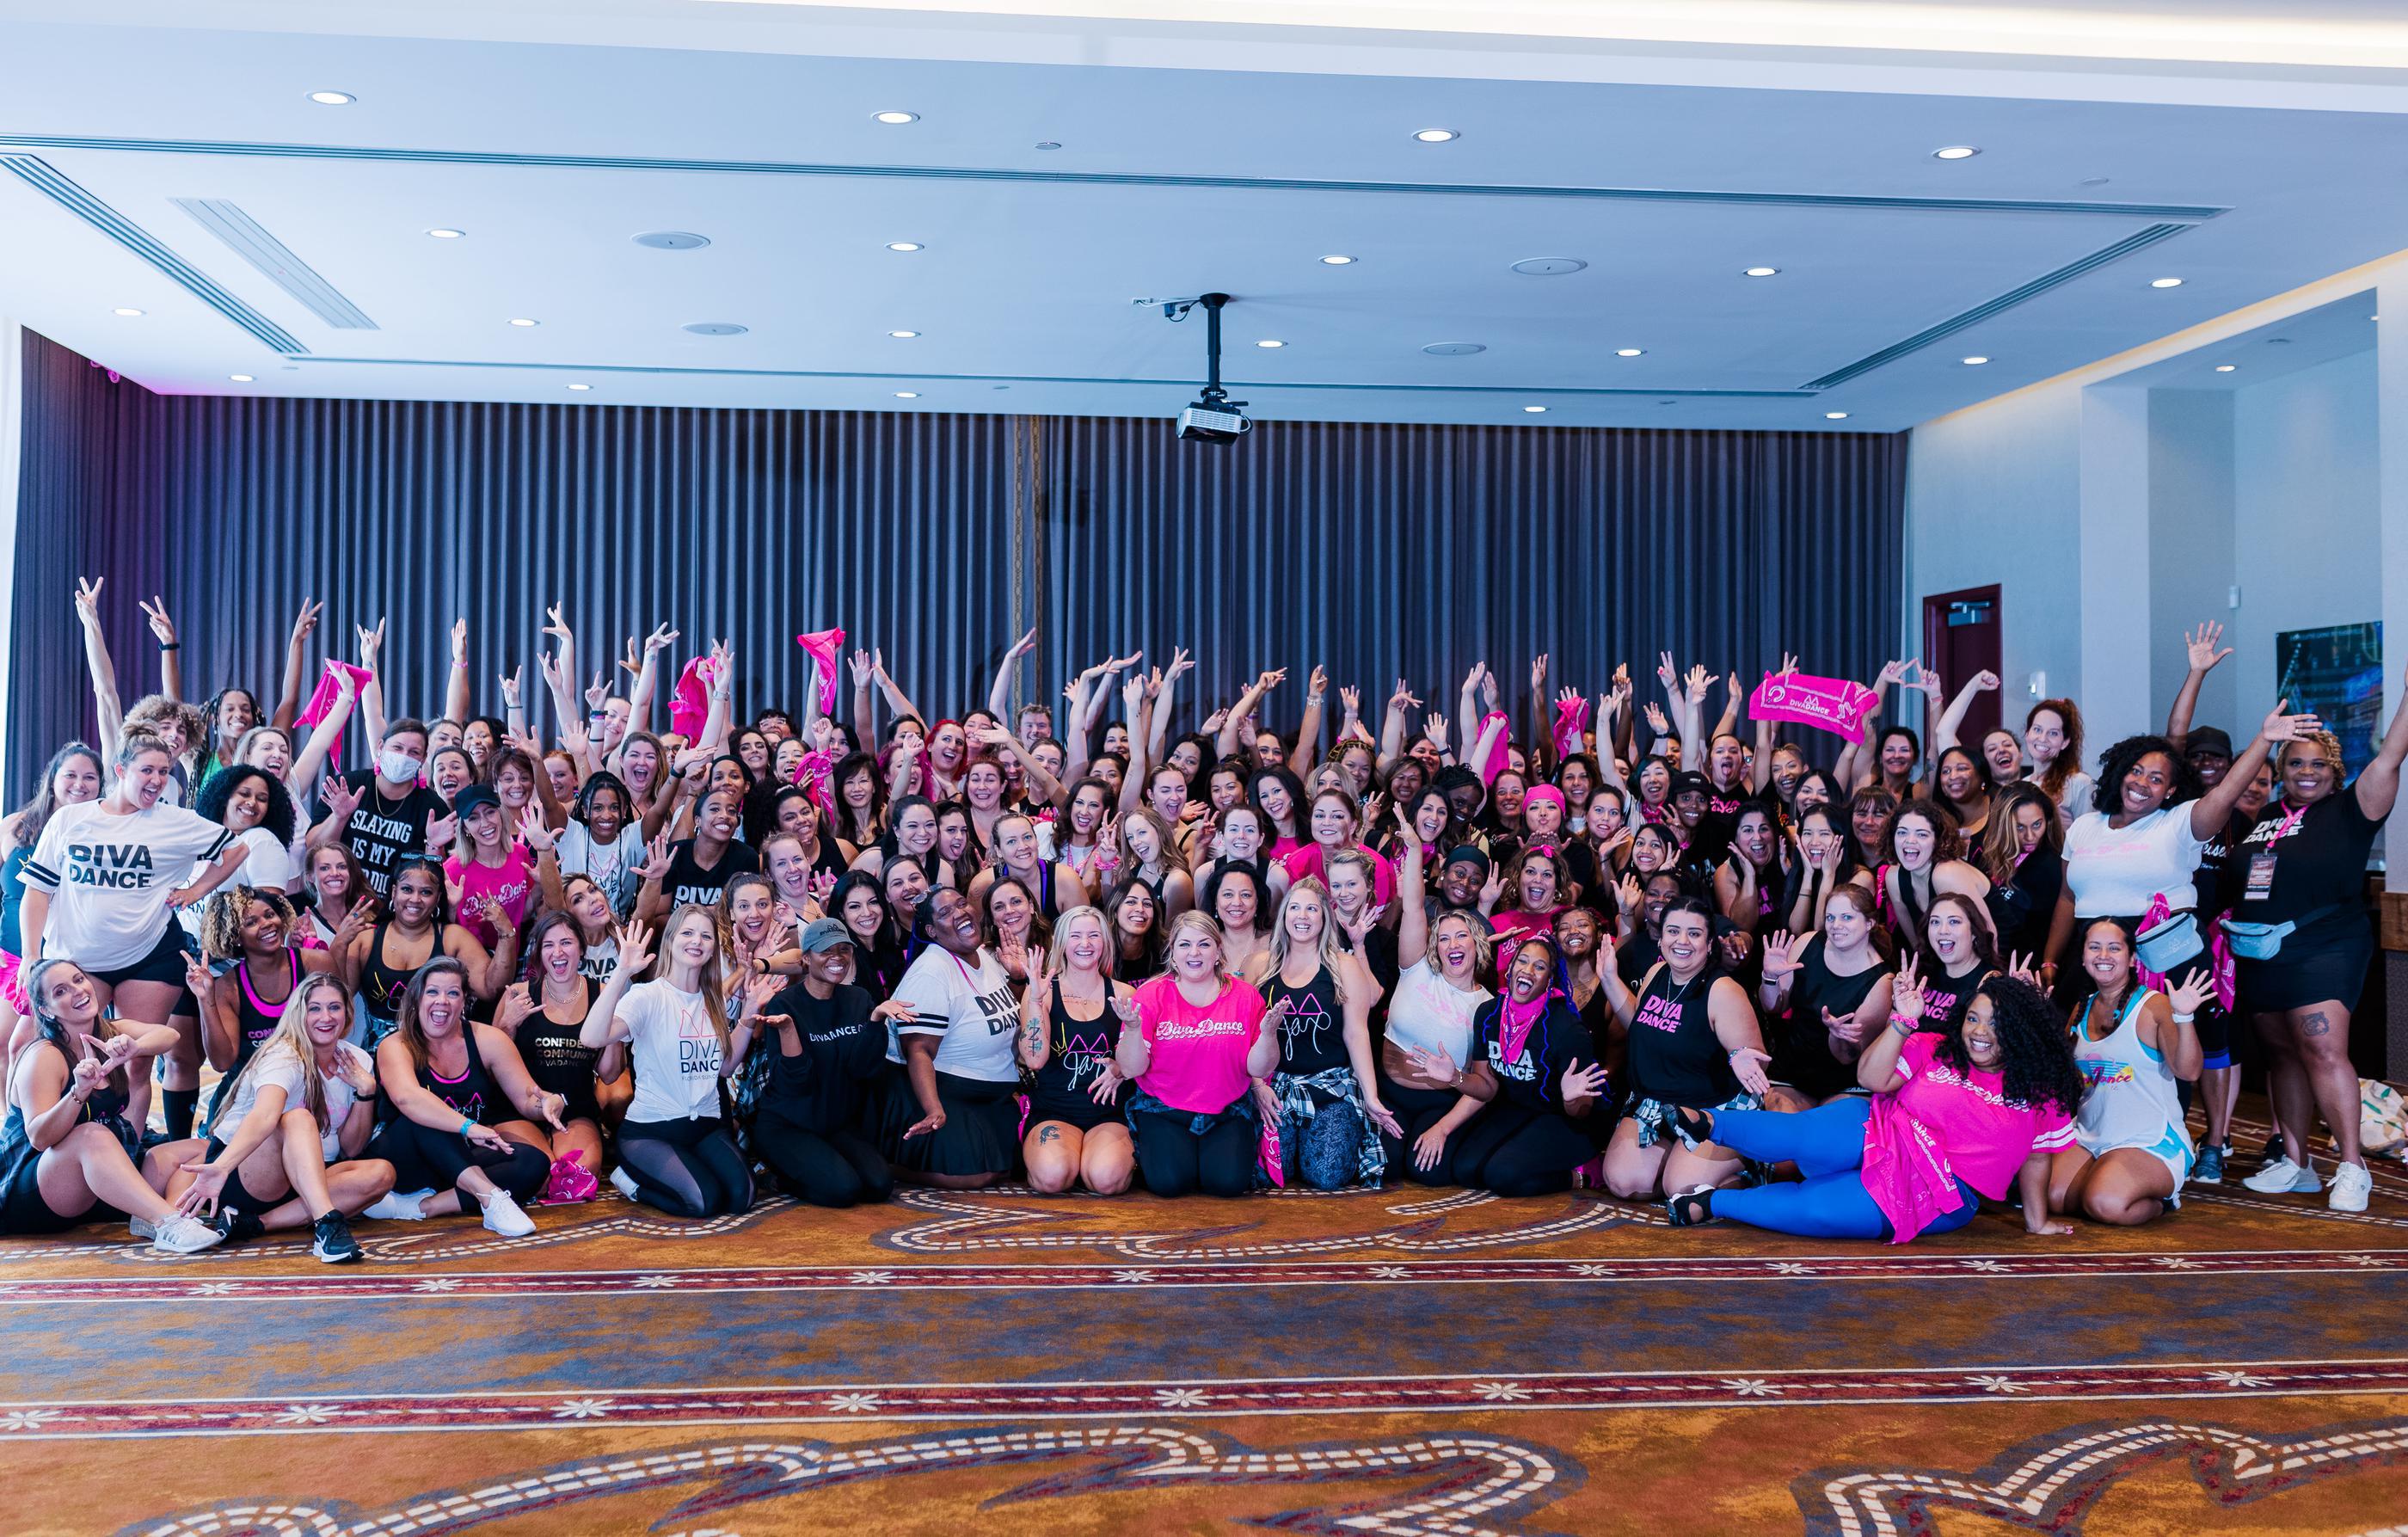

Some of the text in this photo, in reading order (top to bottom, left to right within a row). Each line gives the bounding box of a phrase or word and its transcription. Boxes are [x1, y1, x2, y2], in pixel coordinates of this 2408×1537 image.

[350, 809, 412, 844] SLAYING
[68, 845, 153, 870] DIVA
[352, 837, 396, 867] IS MY
[69, 863, 152, 889] DANCE
[675, 885, 722, 906] DIVA
[1643, 994, 1683, 1020] DIVA
[1637, 1011, 1678, 1033] DANCE
[680, 1059, 719, 1074] DANC
